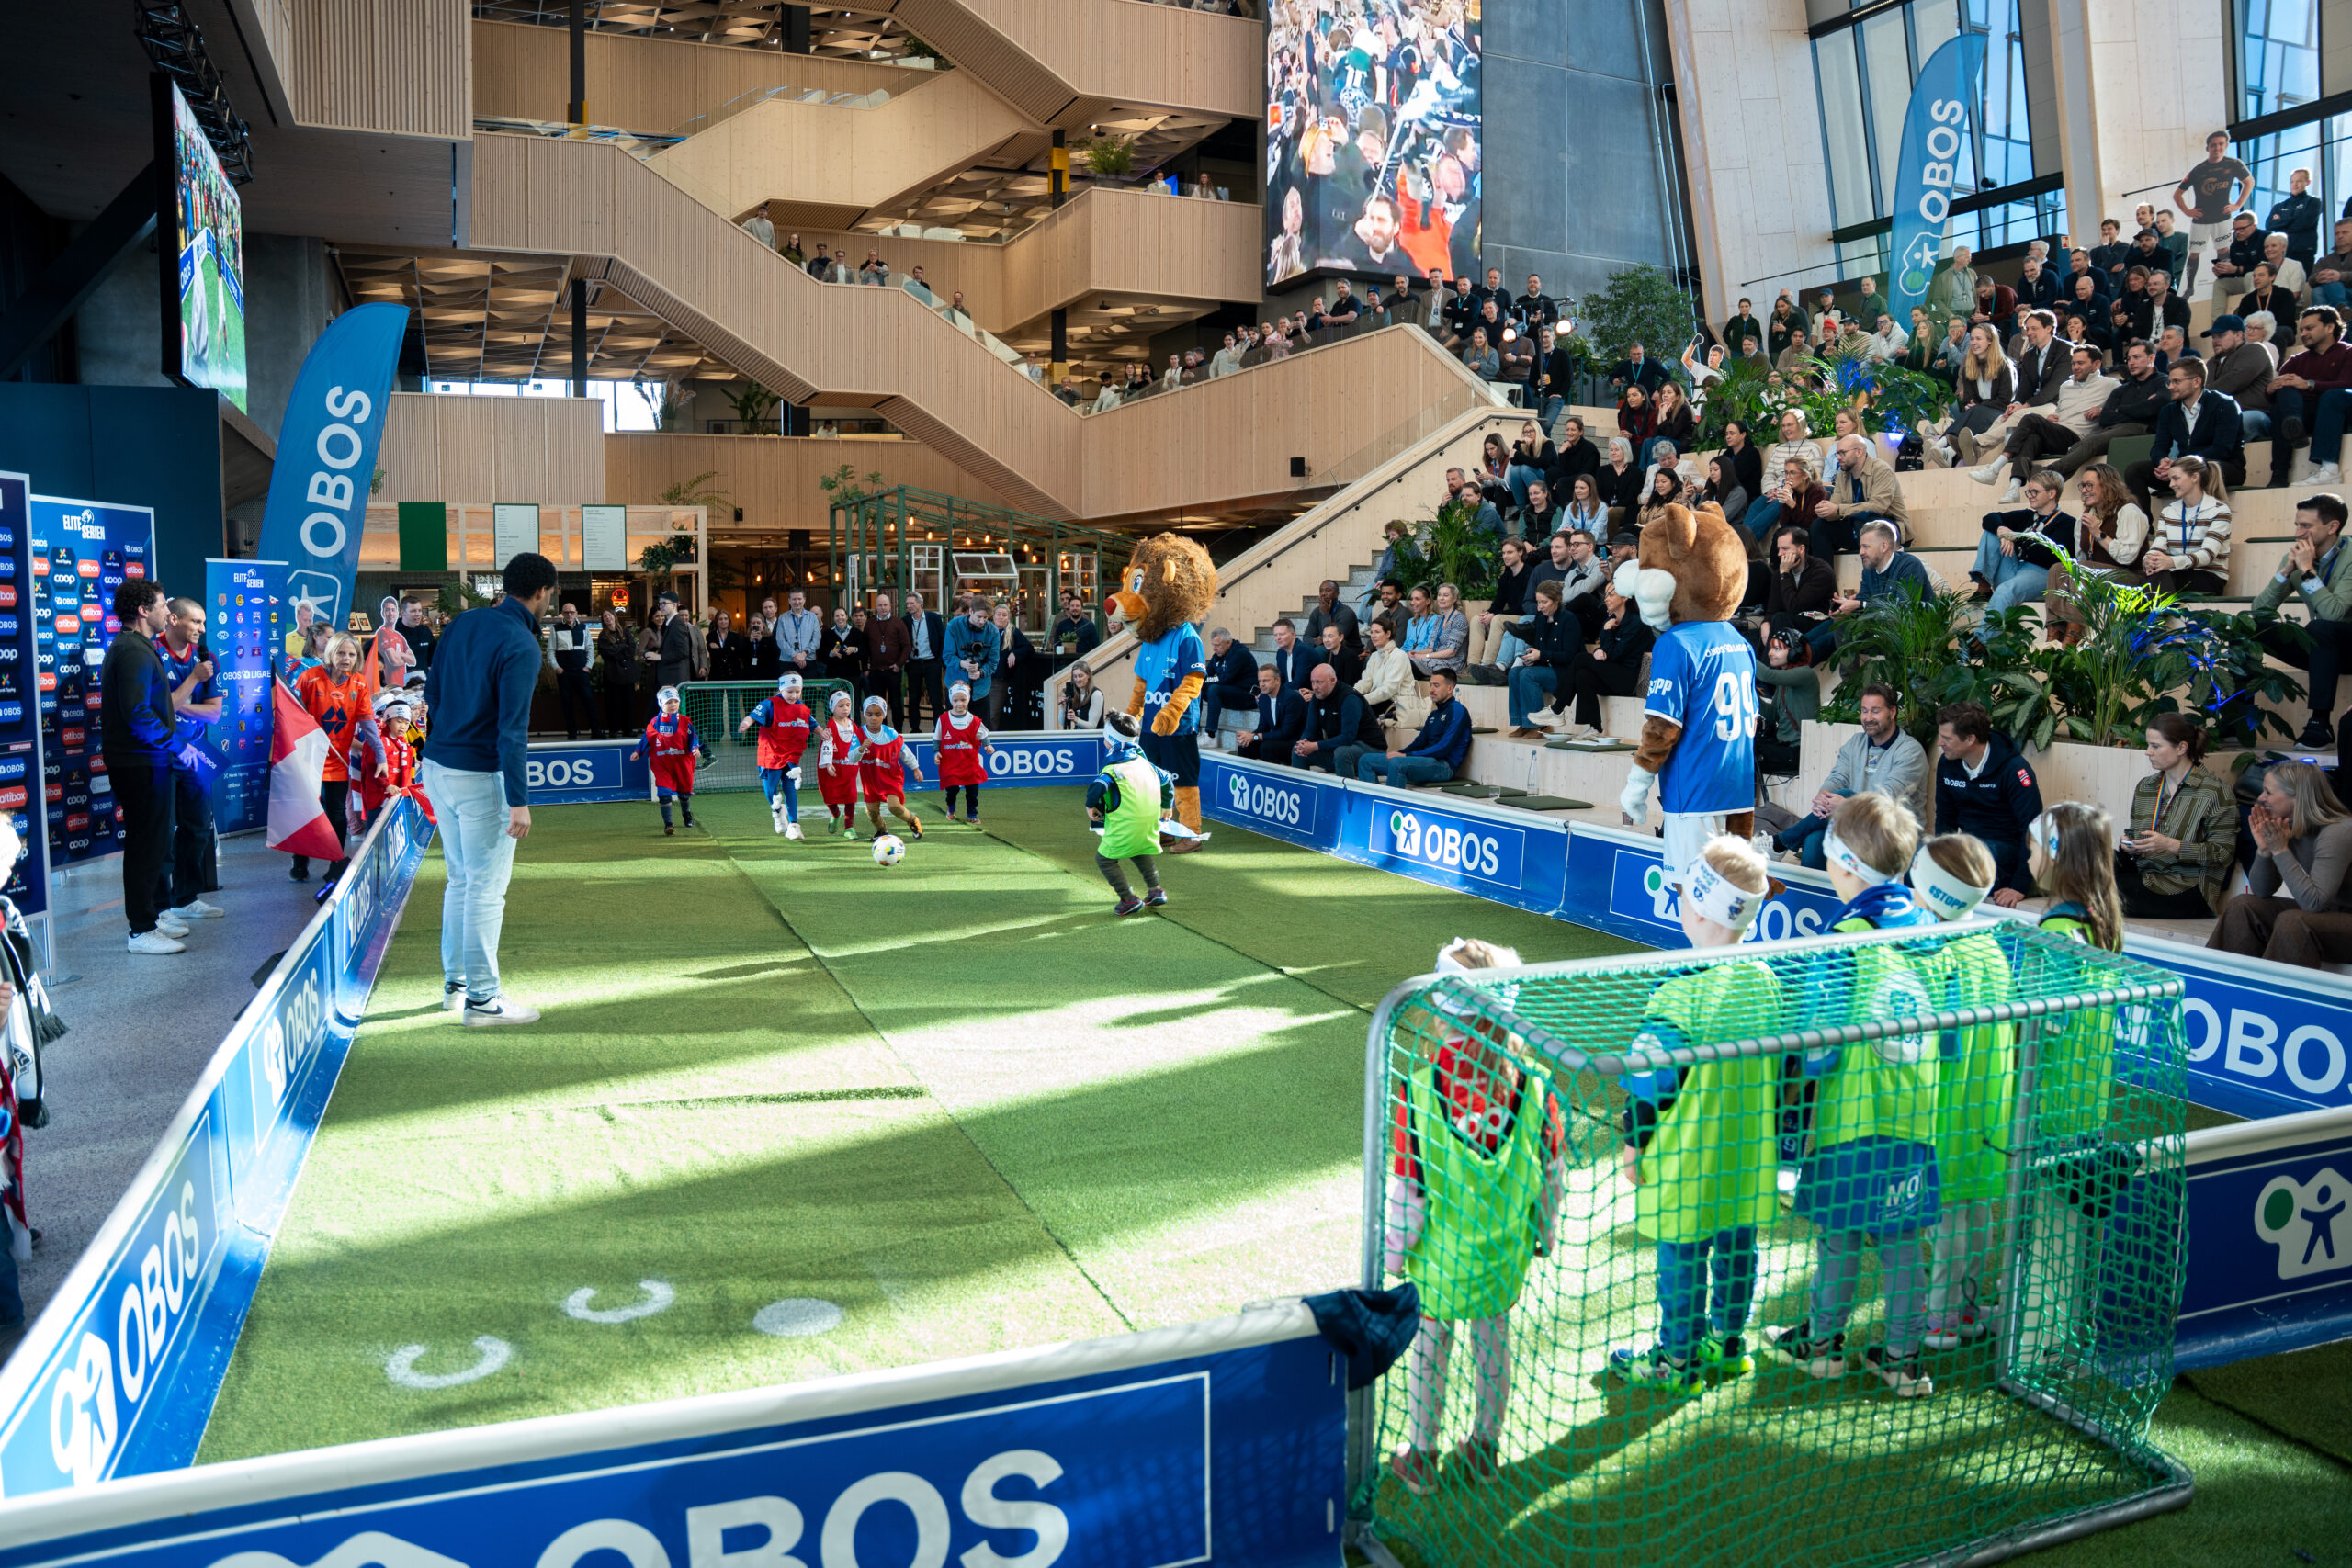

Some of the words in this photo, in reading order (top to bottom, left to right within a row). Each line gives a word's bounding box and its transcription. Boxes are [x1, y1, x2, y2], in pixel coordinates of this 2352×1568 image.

[1918, 97, 1964, 223] OBOS
[300, 385, 372, 558] OBOS
[62, 514, 82, 531] ELITE
[82, 525, 105, 540] SERIEN
[54, 574, 75, 585] coop
[104, 576, 123, 586] coop
[233, 573, 247, 583] ELITE
[246, 579, 264, 588] SERIEN
[60, 664, 81, 675] coop
[222, 671, 242, 680] OBOS
[3, 707, 21, 716] OBOS
[1714, 670, 1757, 742] 99
[6, 764, 25, 773] OBOS
[989, 749, 1074, 775] OBOS
[1950, 779, 1966, 788] OBOS
[67, 795, 87, 805] coop
[1252, 784, 1301, 825] OBOS
[69, 839, 89, 850] coop
[1424, 829, 1499, 876] OBOS
[284, 966, 320, 1074] OBOS
[2168, 998, 2352, 1104] OBO
[119, 1179, 199, 1404] OBOS
